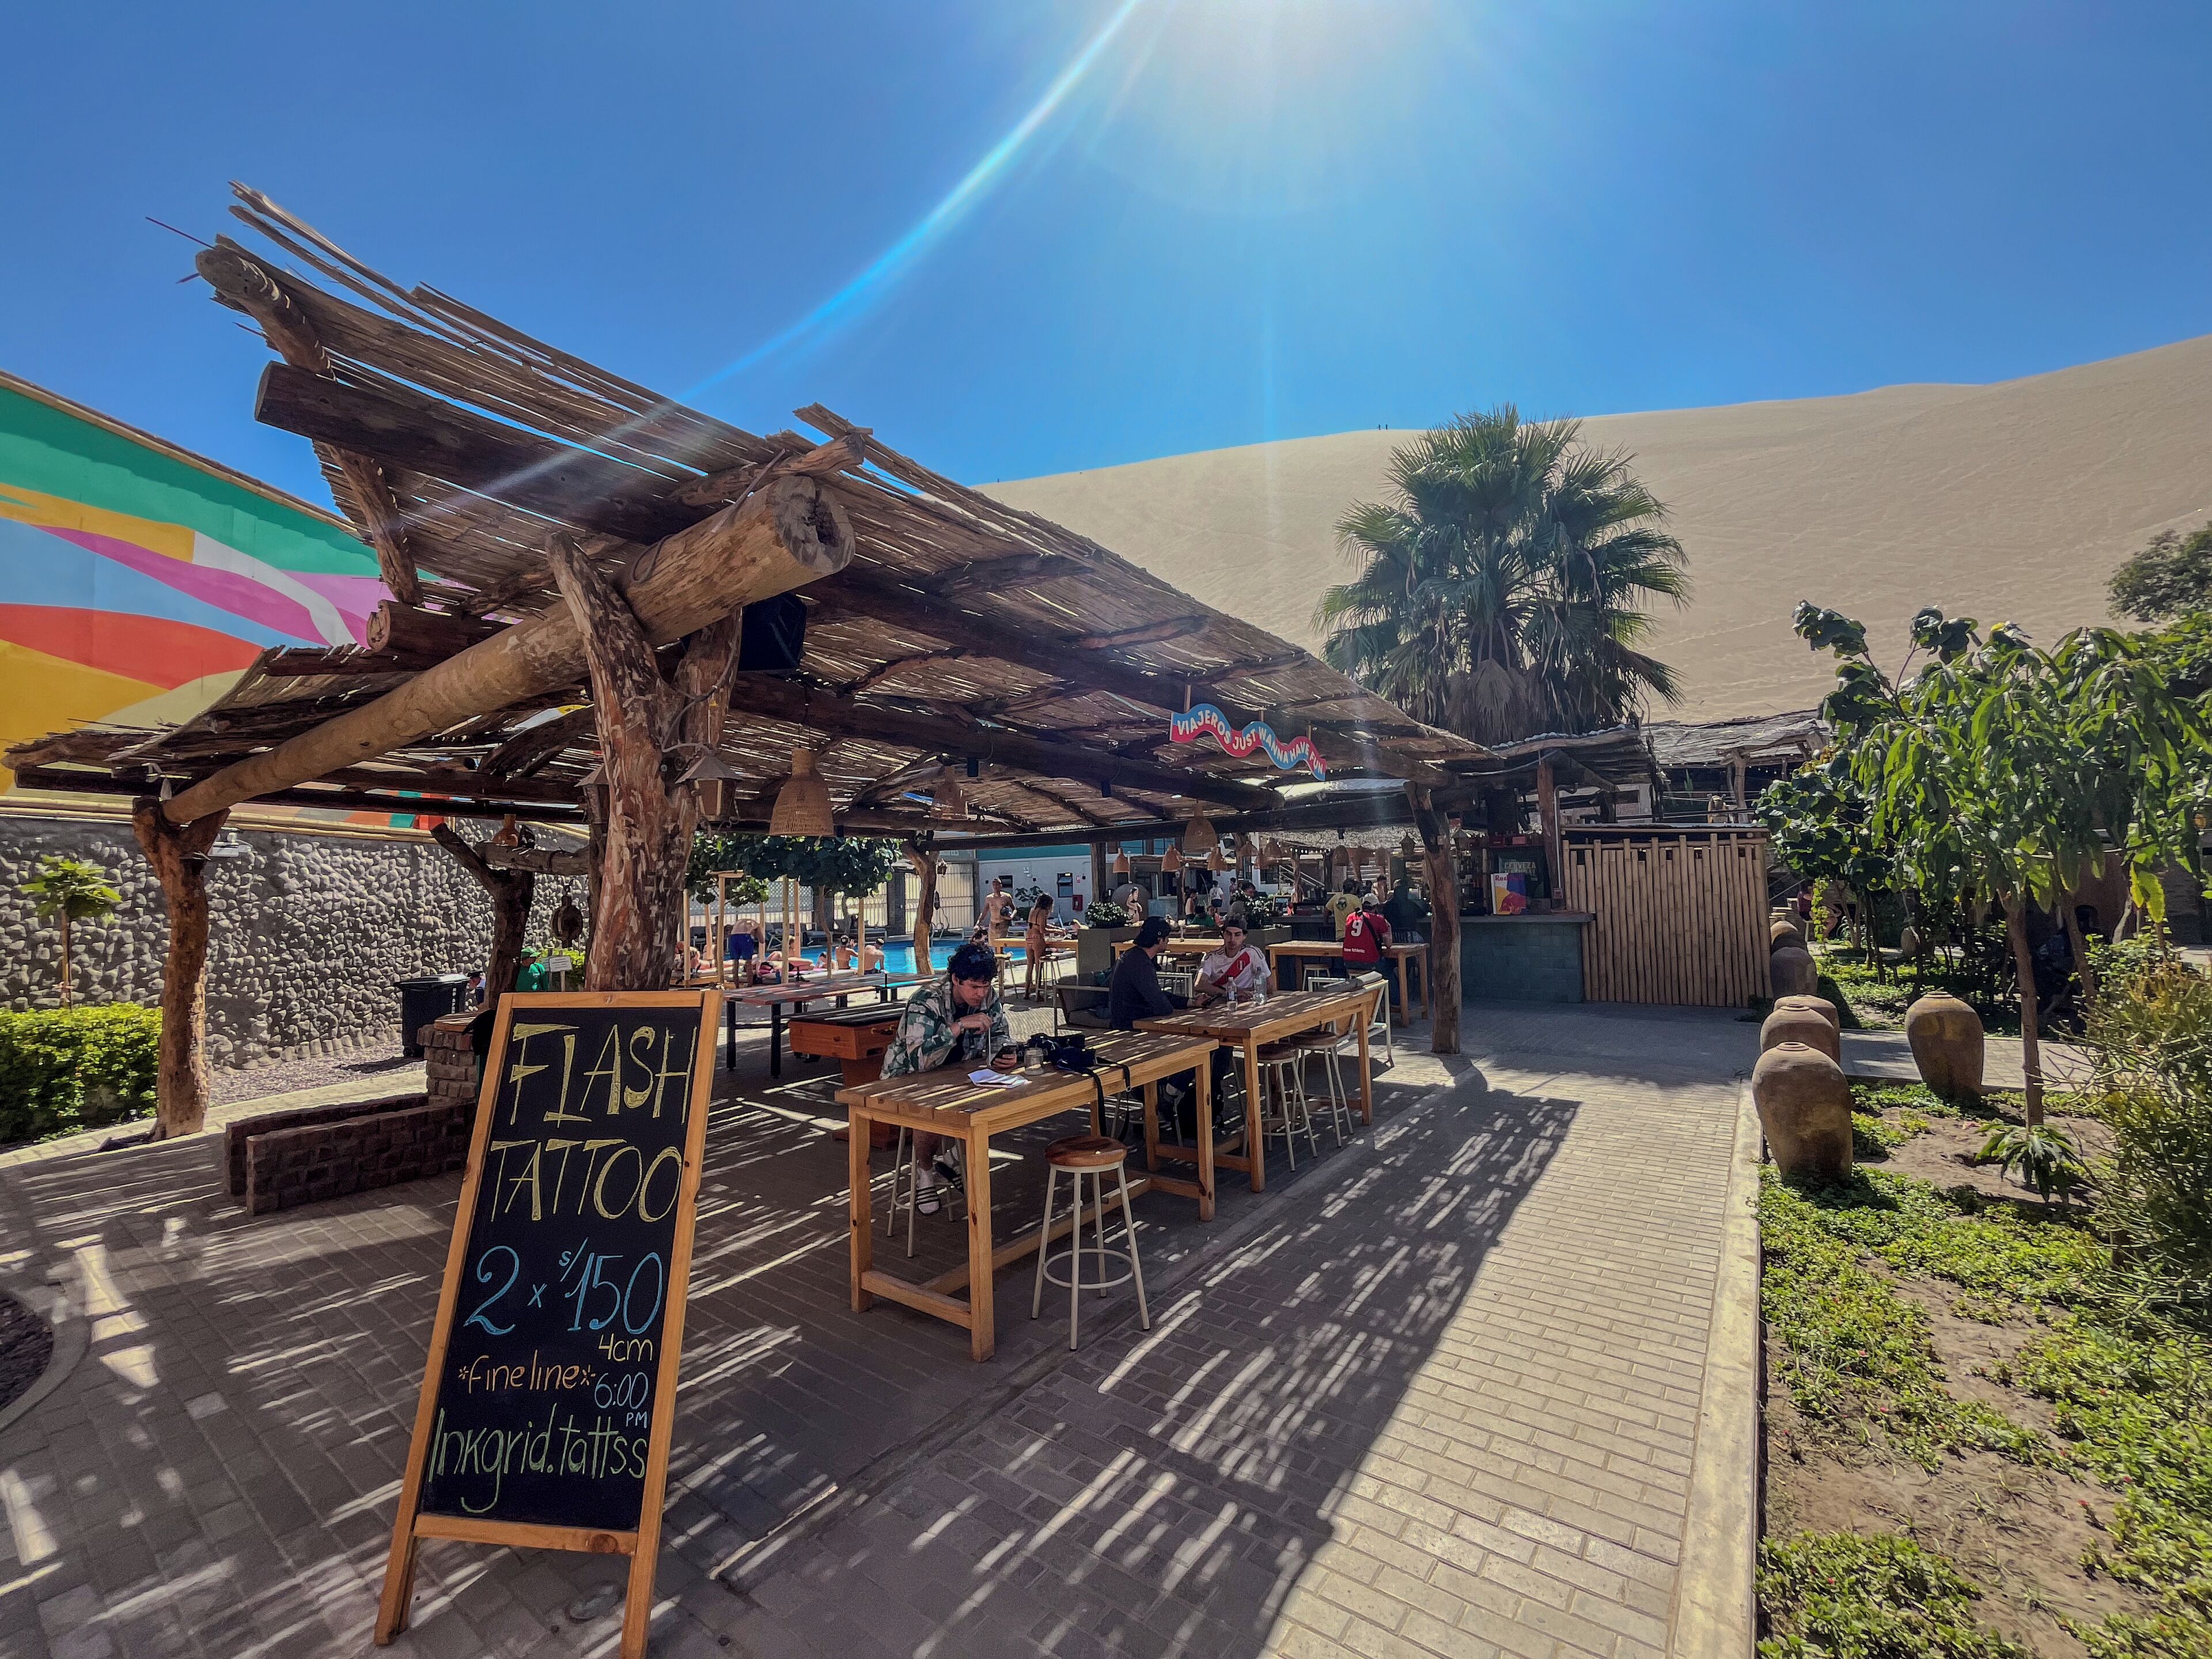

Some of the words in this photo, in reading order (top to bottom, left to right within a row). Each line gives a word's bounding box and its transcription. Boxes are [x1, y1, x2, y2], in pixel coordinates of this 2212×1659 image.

[1177, 710, 1232, 744] VIAJEROS
[1233, 730, 1257, 751] JUST
[1258, 726, 1289, 764] WANNA
[1290, 741, 1310, 762] HAVE
[1309, 752, 1324, 775] FUN
[1351, 919, 1363, 937] 9
[509, 1023, 698, 1128] FLASH
[490, 1138, 682, 1222] TATTOO
[464, 1245, 519, 1335] 2
[599, 1334, 653, 1361] 4cm
[594, 1372, 649, 1410] 6:00
[626, 1411, 647, 1428] PM
